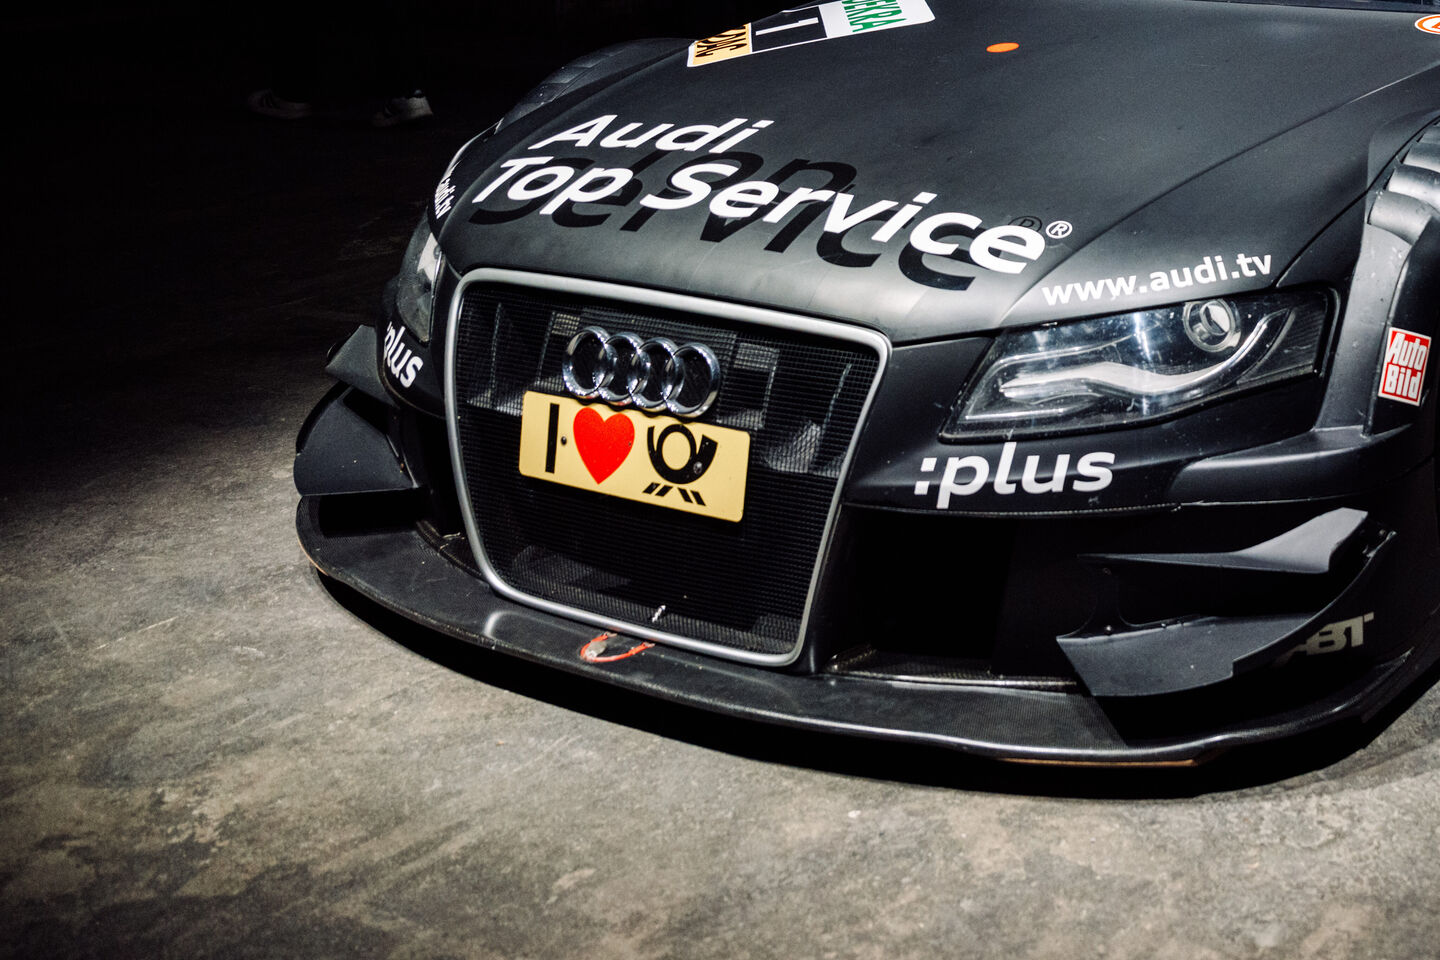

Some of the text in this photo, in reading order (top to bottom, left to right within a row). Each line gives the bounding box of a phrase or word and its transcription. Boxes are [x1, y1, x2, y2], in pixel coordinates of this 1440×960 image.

[528, 114, 775, 154] Audi
[472, 156, 634, 215] Top
[1042, 253, 1271, 306] www.audi.tv
[1386, 332, 1428, 371] Auto
[1384, 363, 1421, 400] Bild
